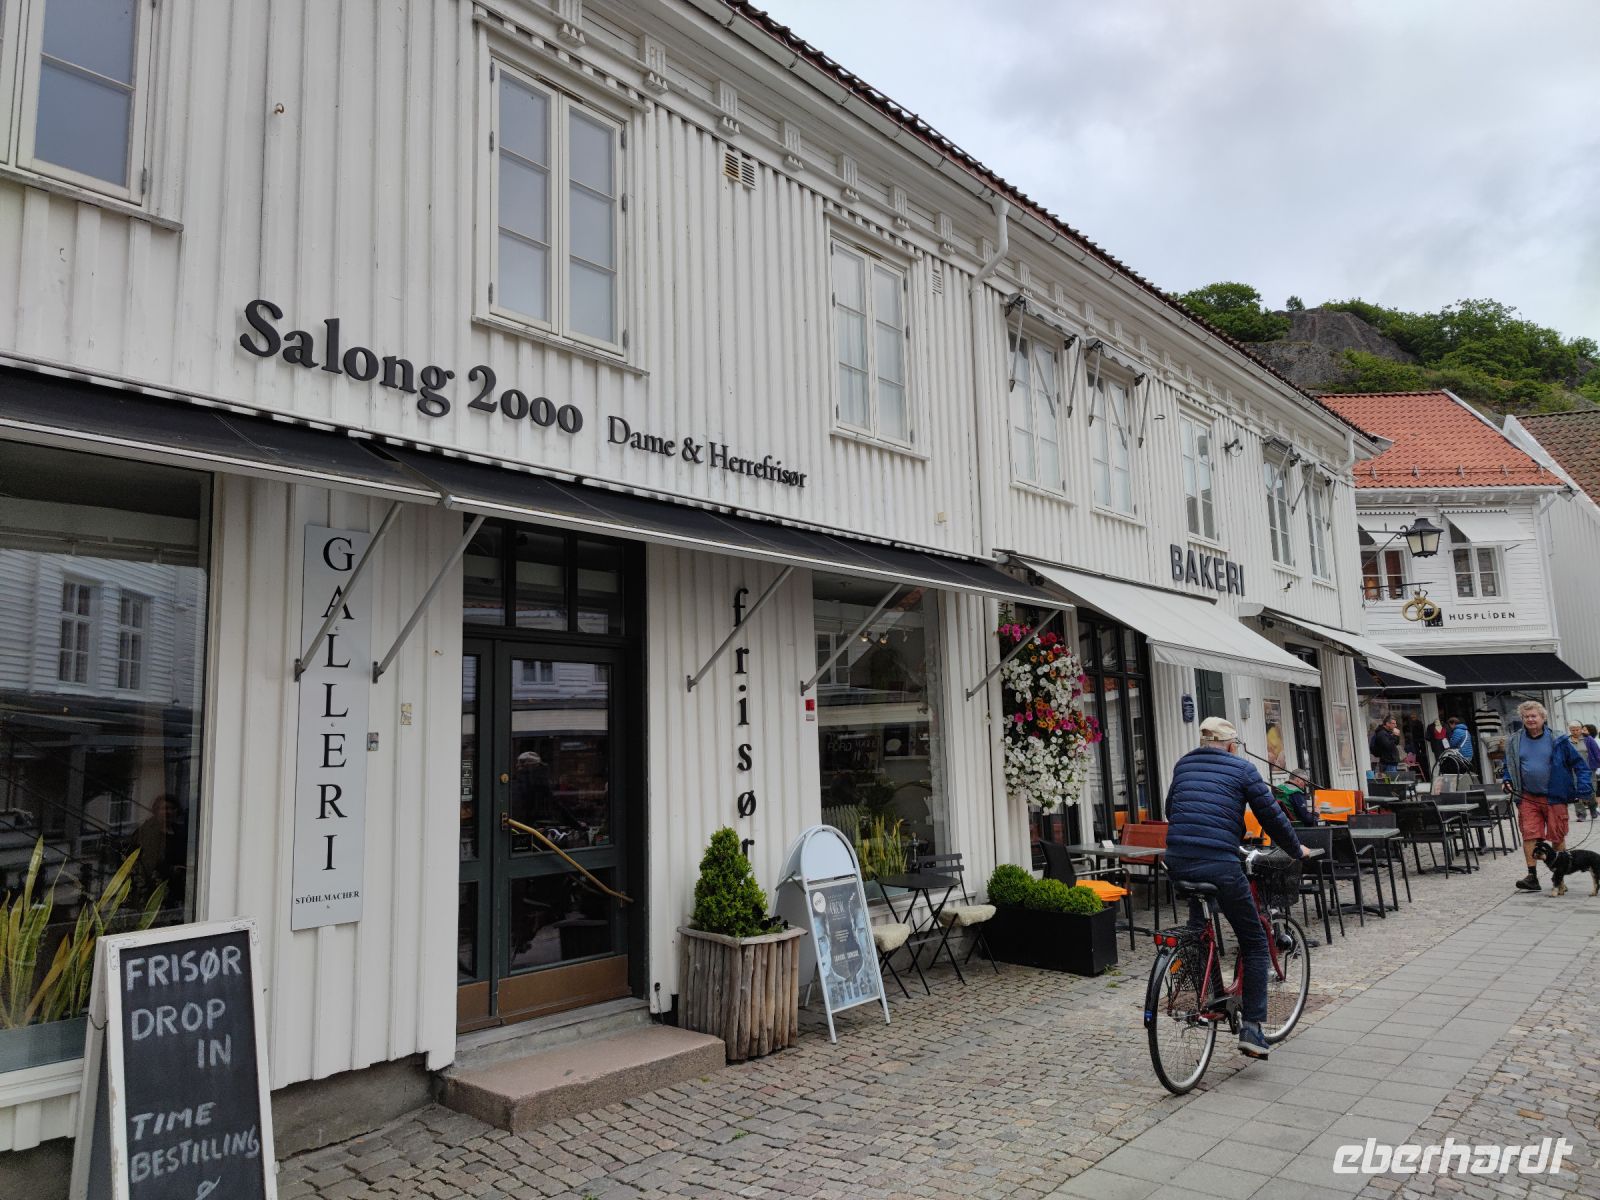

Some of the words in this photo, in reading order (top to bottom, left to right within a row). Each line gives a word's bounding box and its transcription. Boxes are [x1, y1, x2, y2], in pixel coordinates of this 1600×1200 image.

[239, 299, 456, 418] Salong
[467, 365, 583, 434] 2000
[607, 415, 676, 457] Dame
[681, 437, 704, 465] &
[708, 441, 807, 489] Herrefrisør
[1169, 542, 1246, 597] BAKERI
[314, 537, 357, 871] GALLERI
[732, 588, 757, 862] frisør
[126, 945, 243, 991] FRISØR
[131, 998, 227, 1042] DROP
[197, 1034, 232, 1069] IN
[131, 1101, 216, 1141] TIME
[131, 1124, 260, 1184] BESTILLING
